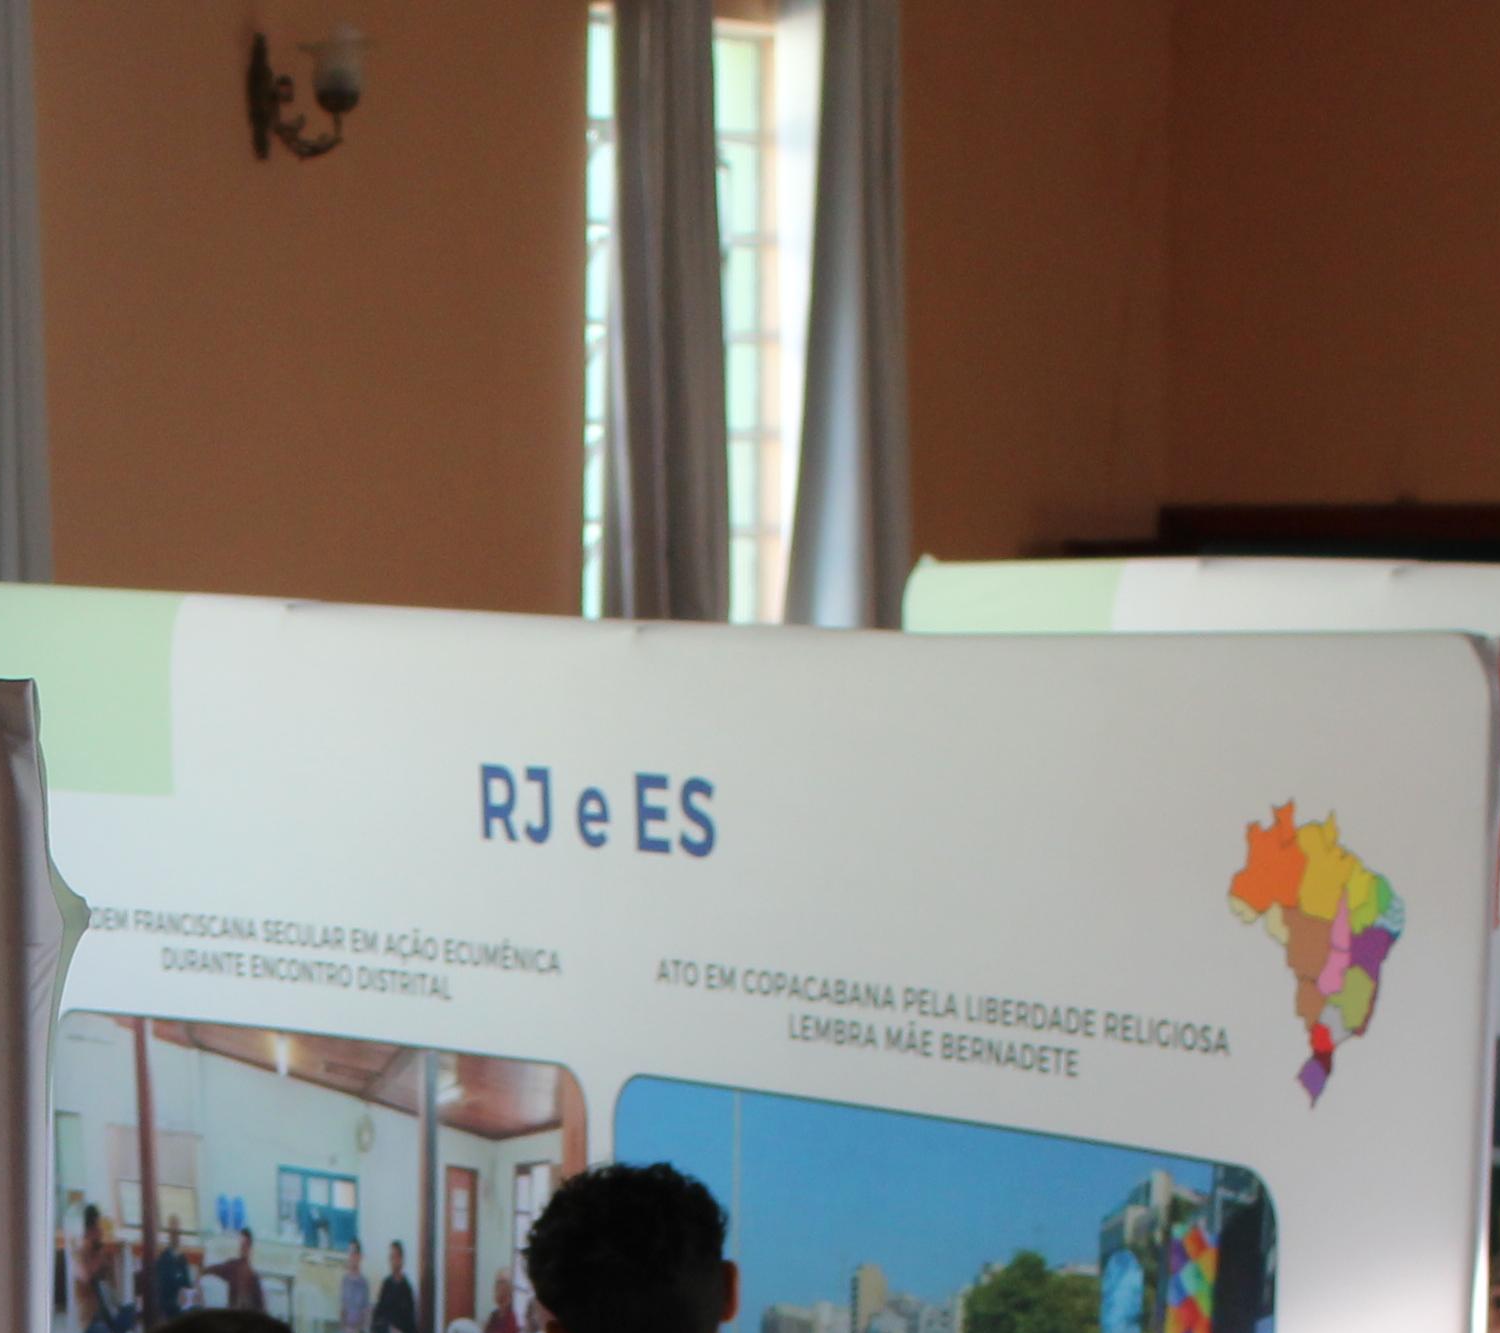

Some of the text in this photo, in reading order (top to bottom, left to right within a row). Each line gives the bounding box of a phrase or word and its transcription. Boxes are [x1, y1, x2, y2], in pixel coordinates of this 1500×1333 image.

[480, 762, 718, 858] RJ e ES
[133, 909, 257, 940] FRANCISCANA
[262, 919, 346, 948] SECULAR
[351, 928, 379, 953] EM
[384, 928, 438, 963] AÇÃO
[444, 938, 562, 975] ECUMÊNICA
[161, 946, 453, 1001] DURANTE ENCONTRO DISTRITAL
[656, 958, 1231, 1056] ATO EM COPACABANA PELA LIBERDADE RELIGIOSA
[788, 1012, 1080, 1078] LEMBRA MÃE BERNADETE
